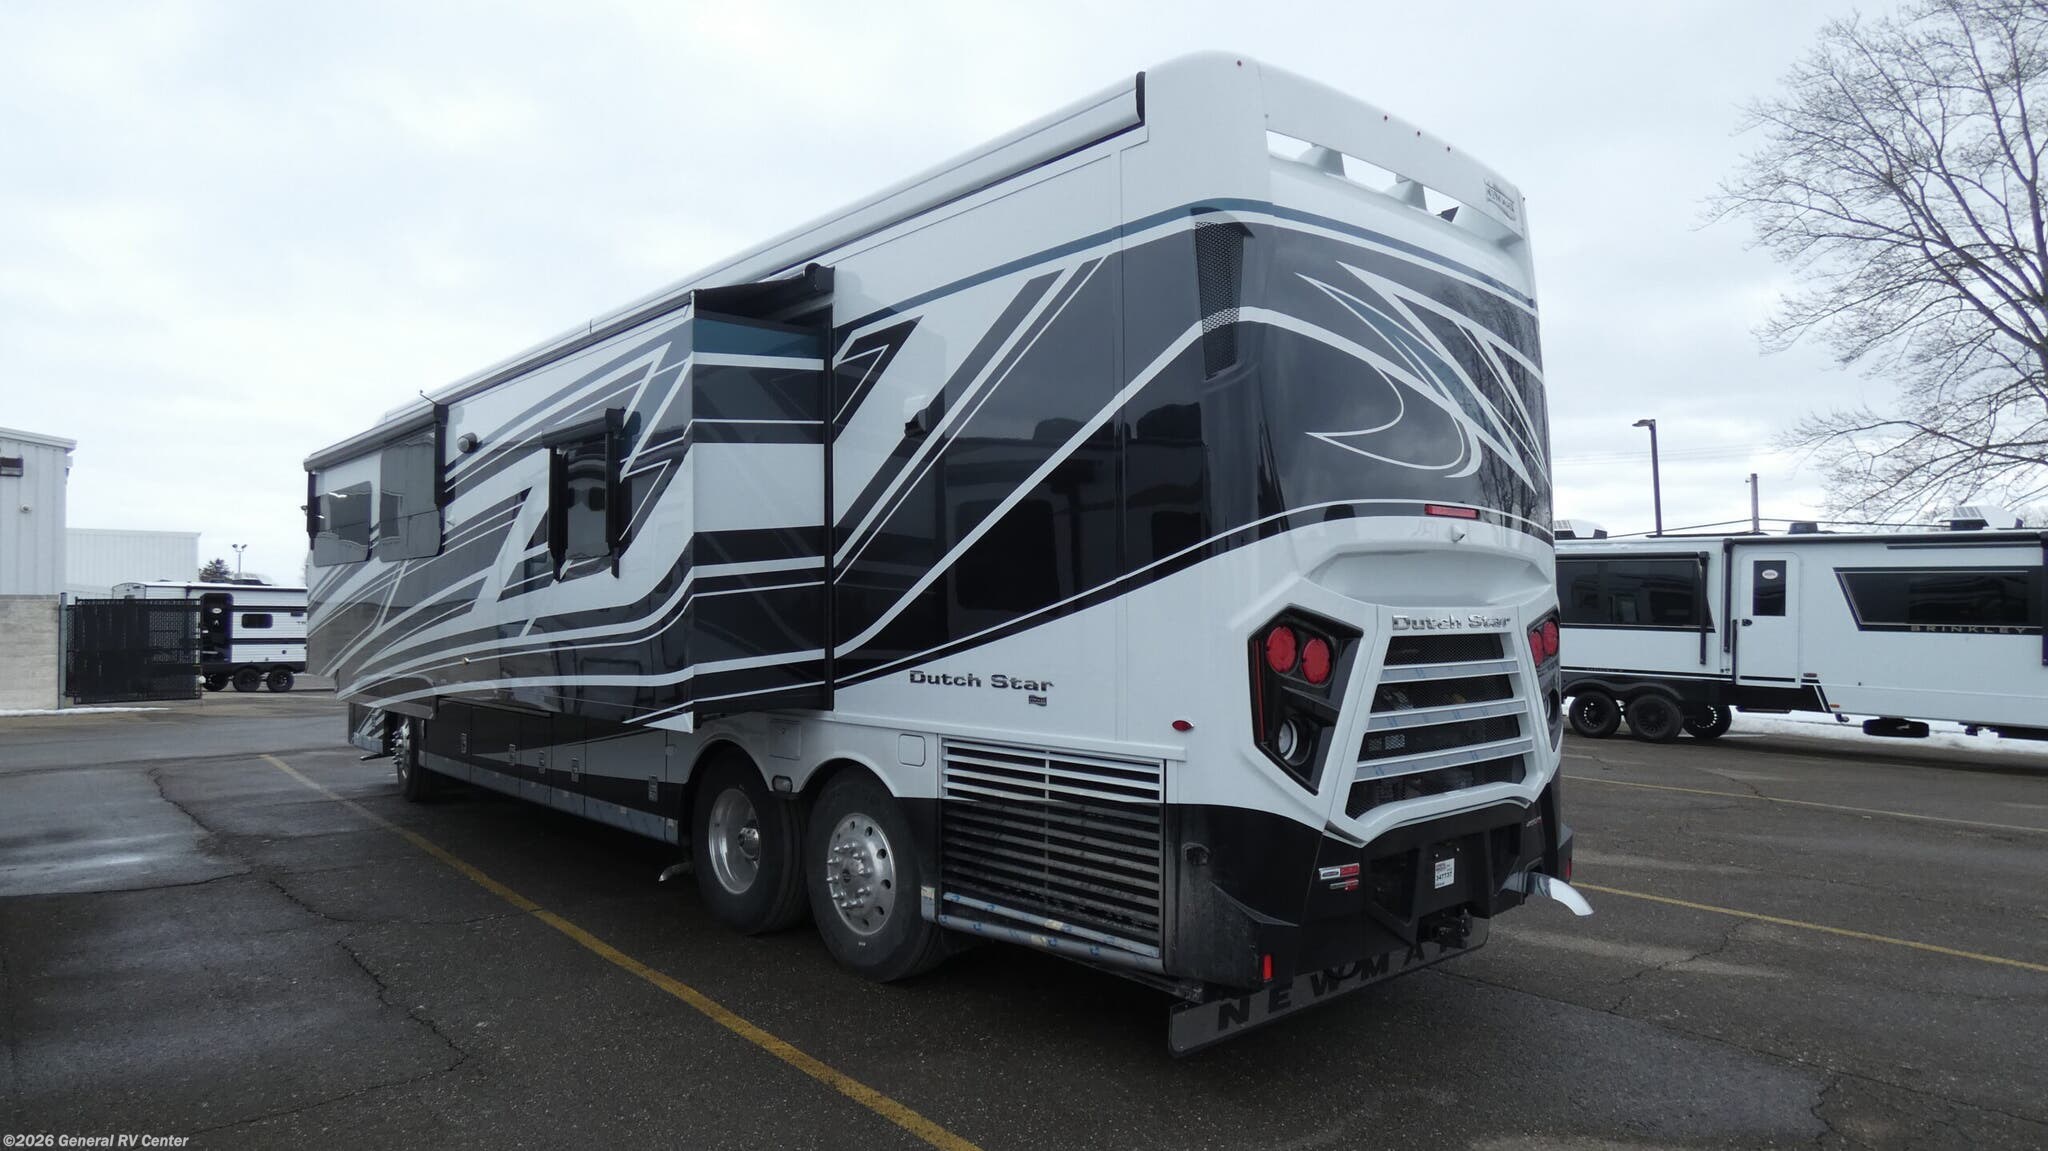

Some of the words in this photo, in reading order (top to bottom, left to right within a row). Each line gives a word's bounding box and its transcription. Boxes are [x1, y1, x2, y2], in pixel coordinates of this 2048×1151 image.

[1392, 614, 1462, 631] Dutch
[1468, 614, 1511, 629] Star
[1911, 624, 2026, 634] BRINKLEY
[909, 670, 982, 687] Dutch
[991, 674, 1055, 691] Star
